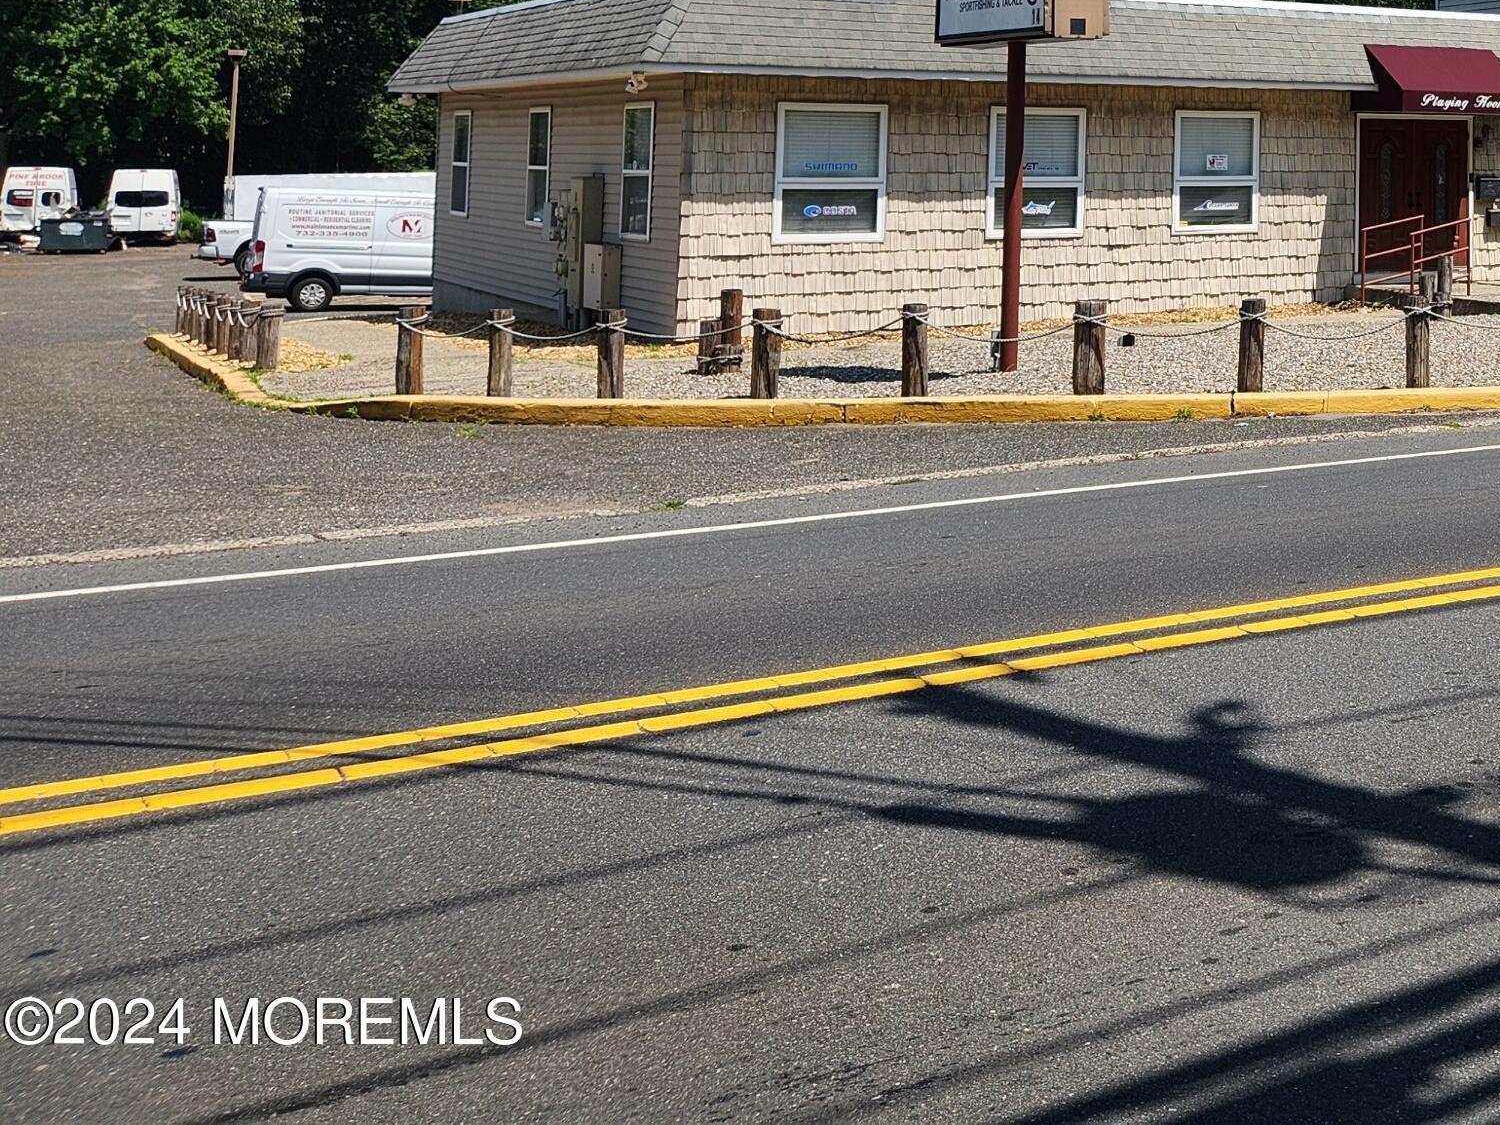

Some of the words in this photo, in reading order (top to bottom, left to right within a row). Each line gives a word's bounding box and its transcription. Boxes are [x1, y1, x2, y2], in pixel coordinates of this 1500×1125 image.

[1032, 7, 1040, 25] 14
[1420, 93, 1469, 111] Playing
[805, 162, 858, 171] SHIMANO
